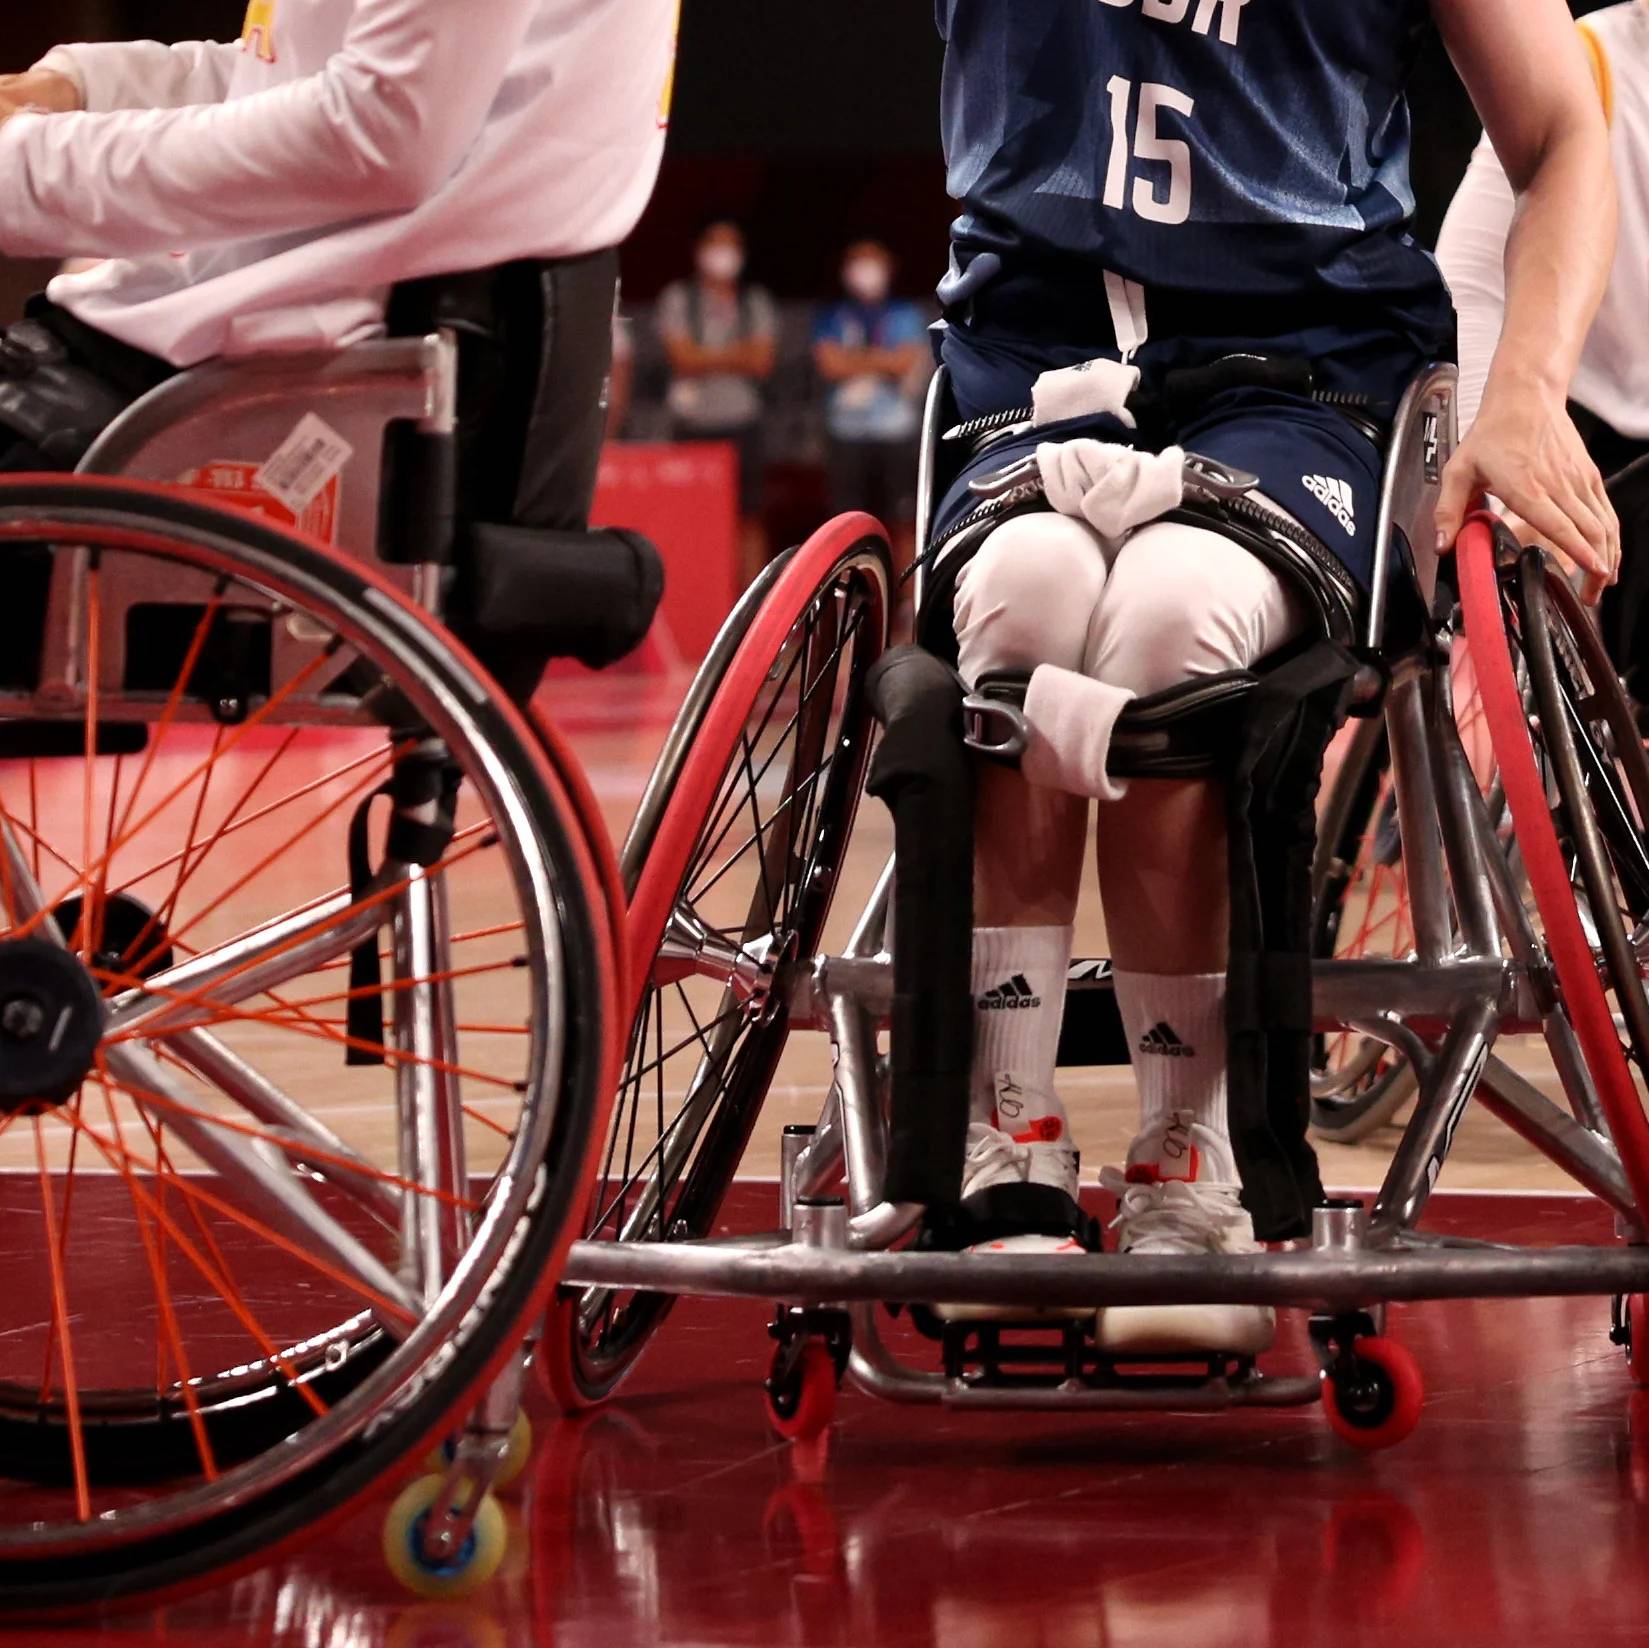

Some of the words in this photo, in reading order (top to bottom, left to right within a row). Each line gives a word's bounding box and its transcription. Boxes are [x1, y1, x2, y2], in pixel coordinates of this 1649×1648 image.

[1102, 74, 1194, 225] 15
[1301, 475, 1356, 537] adidas
[978, 994, 1040, 1010] adidas
[1139, 1040, 1195, 1057] adidas
